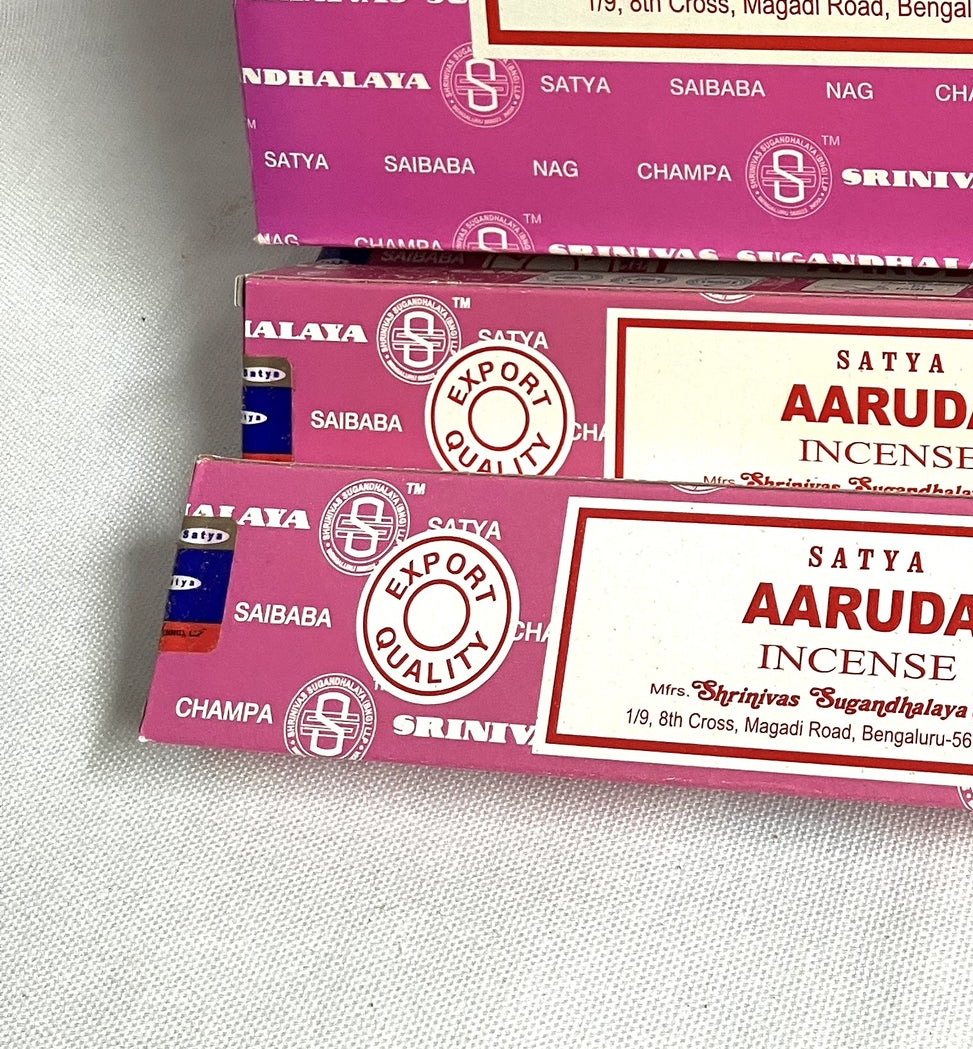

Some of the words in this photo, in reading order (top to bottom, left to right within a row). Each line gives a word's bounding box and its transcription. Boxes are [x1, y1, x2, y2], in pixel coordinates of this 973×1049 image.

[540, 74, 611, 94] SATYA
[670, 77, 766, 97] SAIBABA
[826, 81, 874, 100] NAG
[820, 135, 841, 146] TM
[264, 150, 329, 170] SATYA
[384, 155, 476, 175] SAIBABA
[533, 159, 579, 178] NAG
[637, 162, 732, 182] CHAMPA
[522, 212, 543, 225] TM
[452, 296, 471, 309] TM
[836, 349, 945, 374] SATYA
[447, 361, 552, 406] EXPORT
[310, 410, 403, 433] SAIBABA
[406, 483, 426, 495] TM
[808, 545, 924, 574] SATYA
[385, 552, 496, 602] EXPORT
[233, 601, 332, 628] SAIBABA
[376, 626, 489, 684] QUALITY
[757, 643, 957, 681] INCENSE
[175, 696, 273, 725] CHAMPA
[650, 682, 690, 698] Mfrs.
[692, 680, 800, 710] Shrinivas
[809, 687, 967, 720] Sugandhalaya
[626, 707, 652, 728] 1/9,
[658, 710, 683, 728] 8th
[688, 712, 738, 734] Cross,
[744, 716, 804, 739] Magadi
[808, 719, 856, 743] Road,
